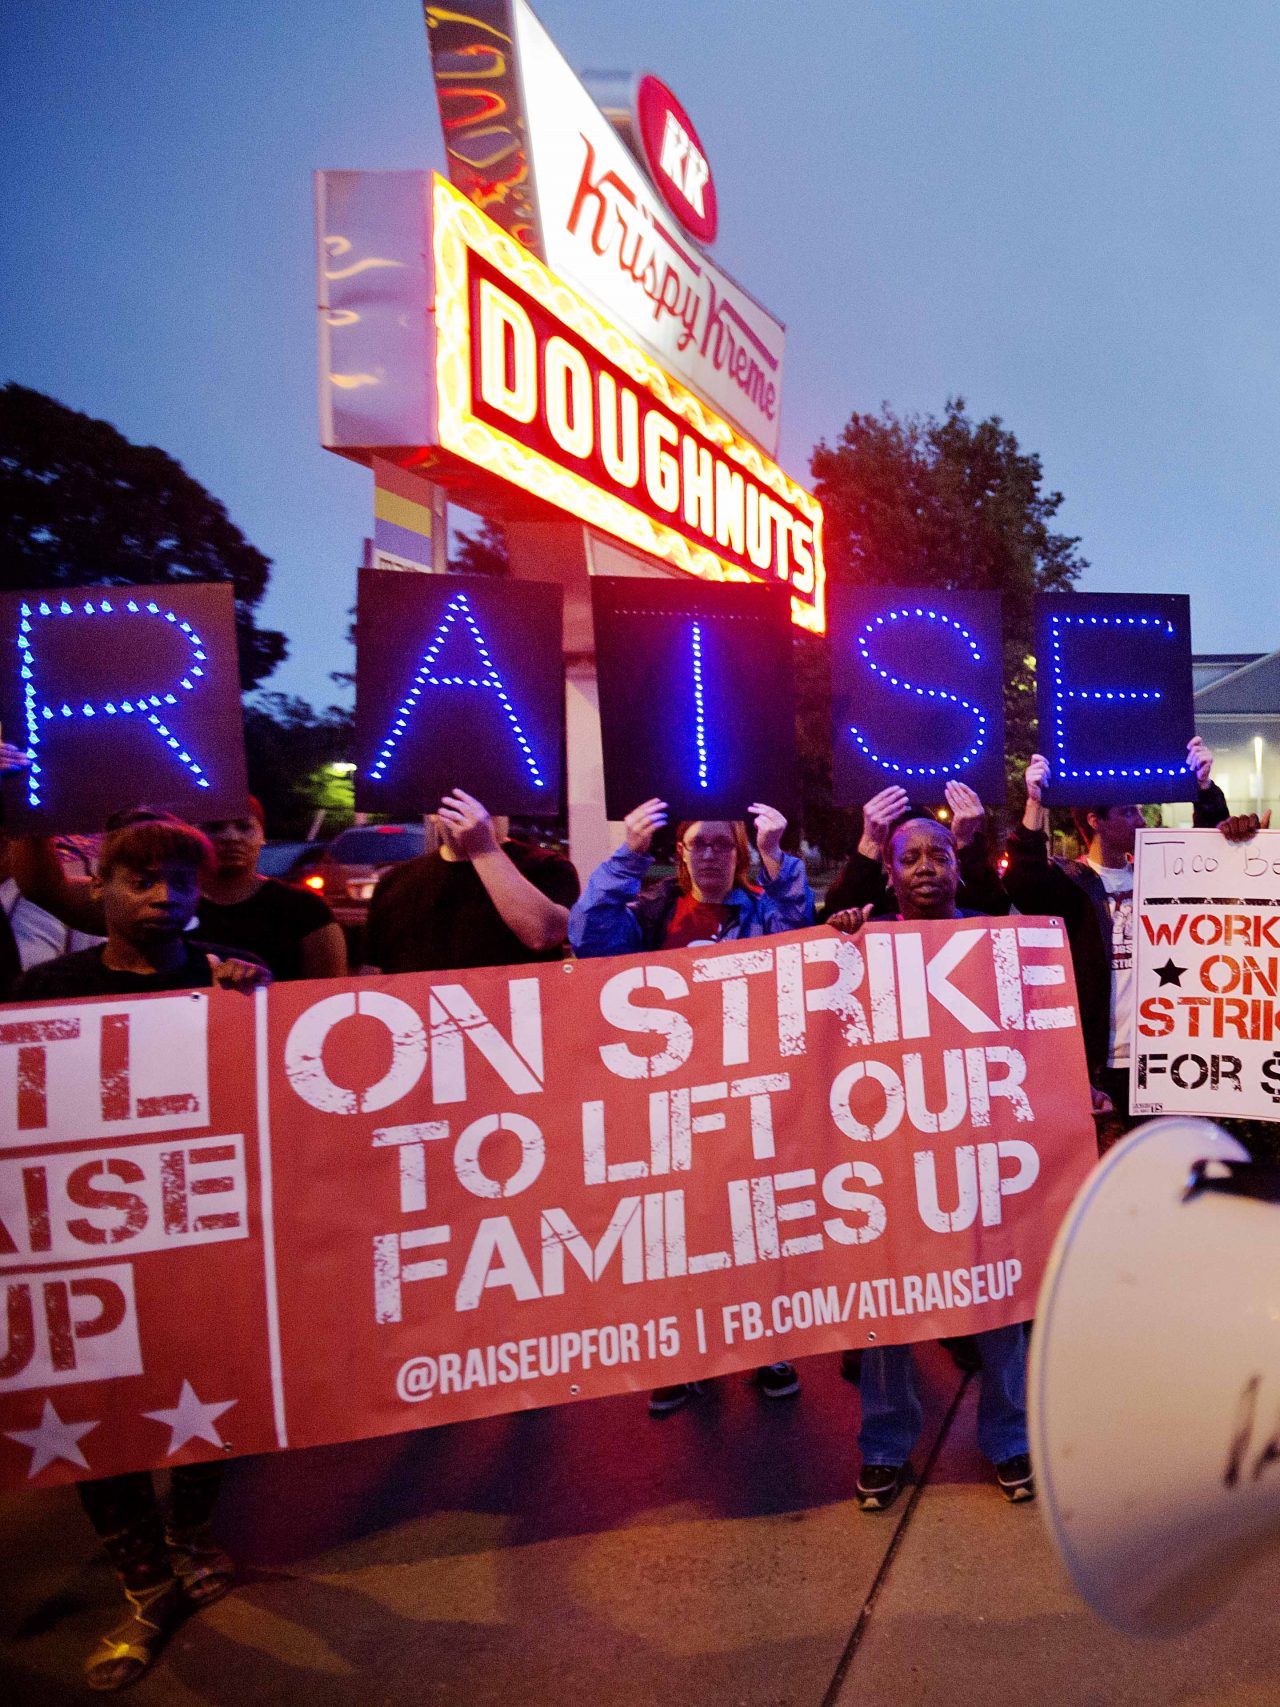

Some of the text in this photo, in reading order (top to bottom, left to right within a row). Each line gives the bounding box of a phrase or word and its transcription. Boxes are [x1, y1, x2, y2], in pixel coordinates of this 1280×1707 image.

[658, 109, 711, 219] KK
[564, 131, 779, 422] Krispy Kreme
[478, 277, 815, 595] DOUGHNUTS
[1144, 840, 1219, 879] Taco
[284, 927, 1077, 1116] ON STRIKE
[1199, 954, 1278, 997] ON
[1137, 1053, 1243, 1093] FOR
[371, 1046, 1036, 1213] TO LIFT OUR
[0, 1144, 241, 1254] ISE
[372, 1140, 1041, 1326] FAMILIES UP
[722, 1258, 1024, 1347] FB.COM/ATLRAISEUP
